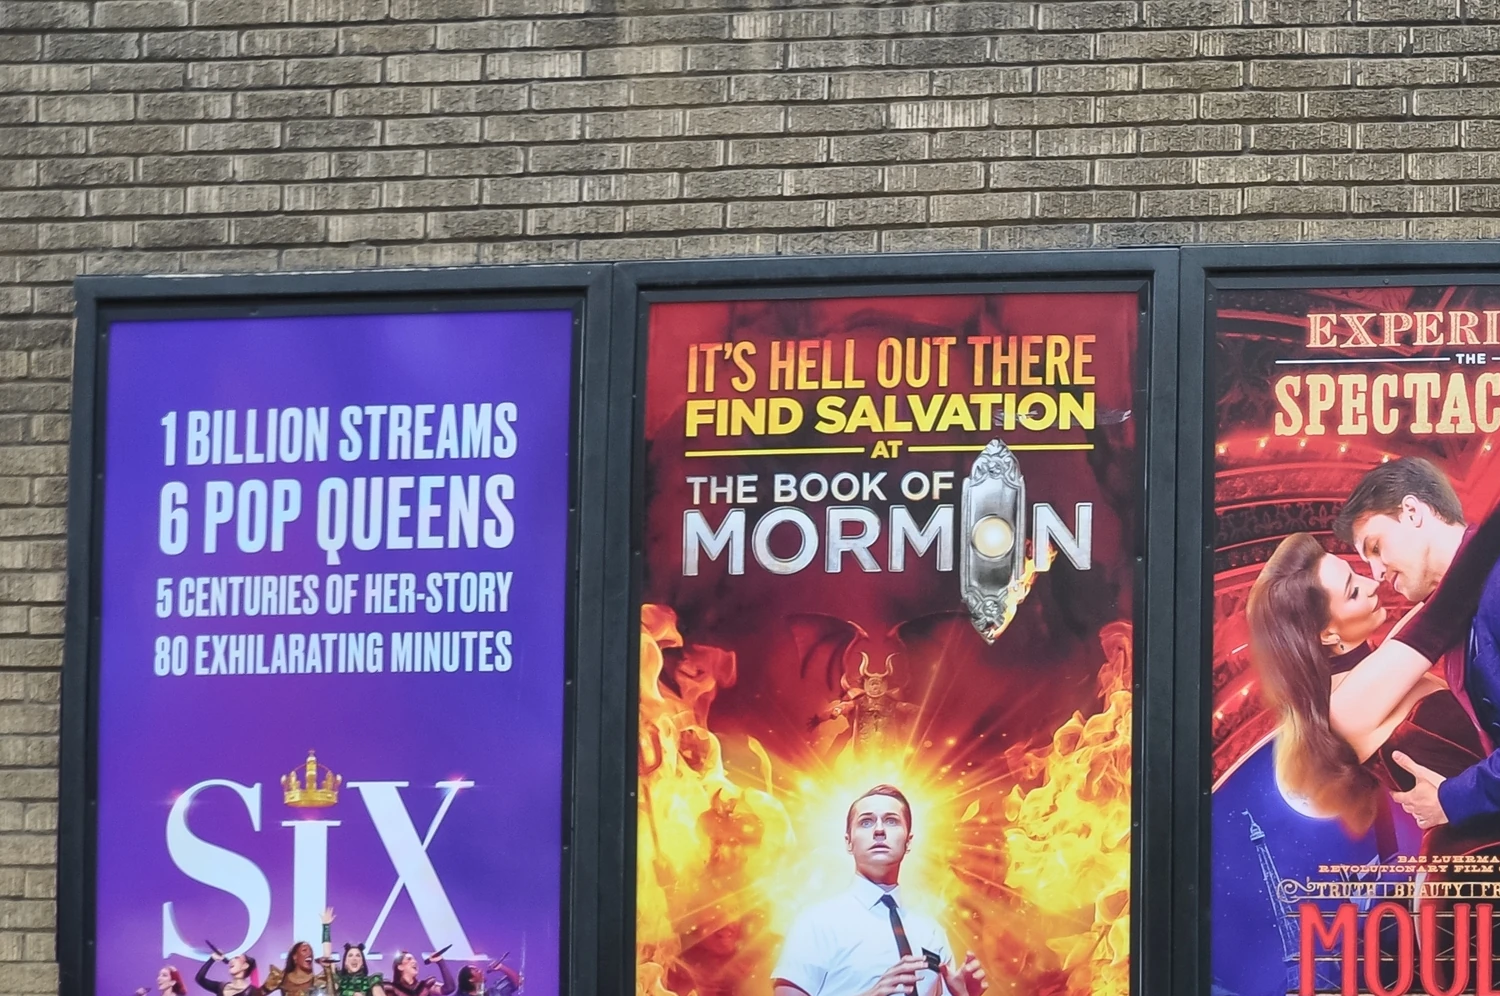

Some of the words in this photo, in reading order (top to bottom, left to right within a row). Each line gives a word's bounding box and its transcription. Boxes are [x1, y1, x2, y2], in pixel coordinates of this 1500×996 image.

[688, 341, 756, 393] IT'S
[770, 339, 865, 390] HELL
[878, 337, 956, 388] OUT
[967, 335, 1095, 386] THERE
[1455, 353, 1486, 365] THE
[161, 412, 176, 466] 1
[186, 407, 329, 465] BILLION
[339, 402, 517, 462] STREAMS
[685, 397, 803, 436] FIND
[815, 392, 1095, 433] SALVATION
[871, 441, 903, 458] AT
[687, 475, 758, 504] THE
[773, 471, 887, 502] BOOK
[901, 471, 954, 500] OF
[159, 481, 189, 555] 6
[203, 479, 301, 553] POP
[317, 475, 515, 565] QUEENS
[157, 578, 172, 618] 5
[179, 574, 318, 616] CENTURIES
[326, 574, 359, 615] OF
[365, 571, 513, 614] HER-STORY
[154, 636, 187, 676] 80
[195, 633, 383, 676] EXHILARATING
[391, 631, 512, 672] MINUTES
[162, 779, 487, 960] SIX
[1318, 865, 1448, 873] REVOLUTIONARY
[1454, 865, 1493, 873] FILM
[1398, 855, 1427, 863] BAZ
[1316, 884, 1376, 897] TRUTH
[1394, 883, 1463, 897] BEAUTY
